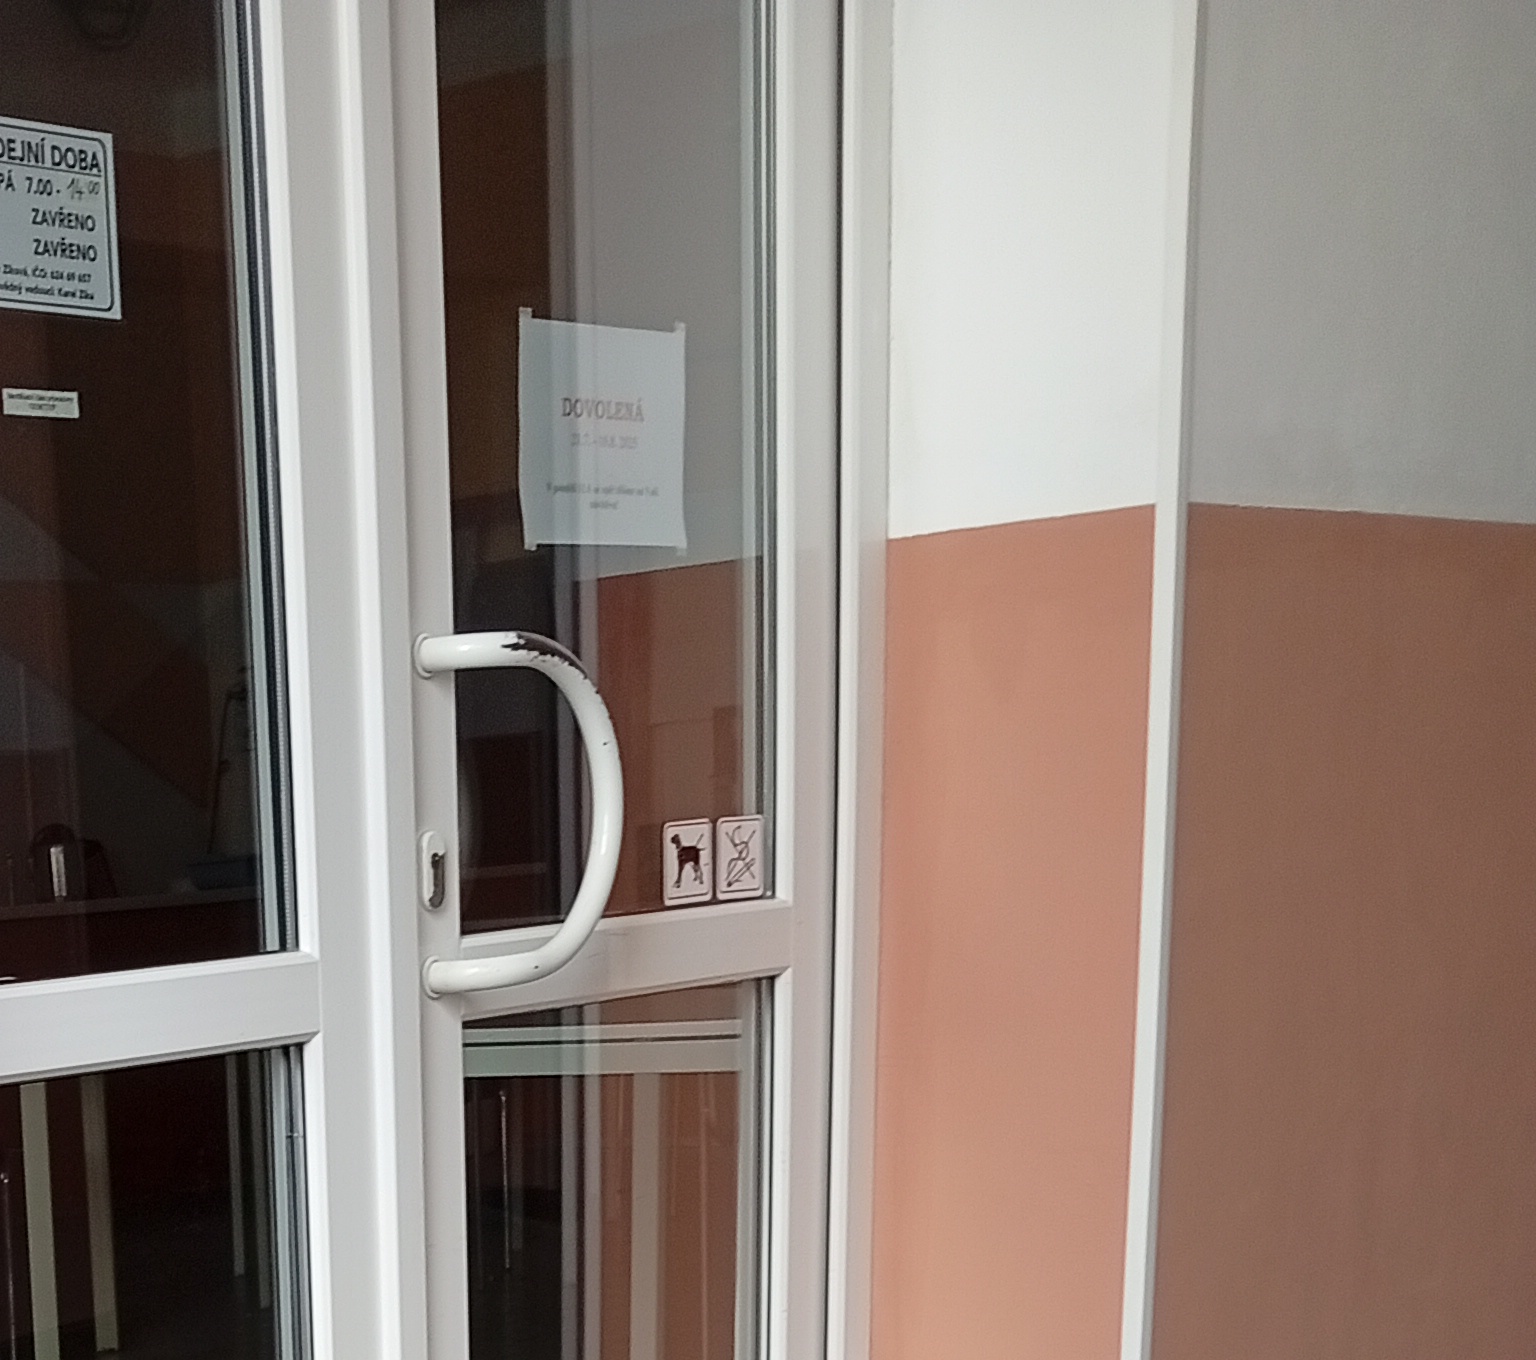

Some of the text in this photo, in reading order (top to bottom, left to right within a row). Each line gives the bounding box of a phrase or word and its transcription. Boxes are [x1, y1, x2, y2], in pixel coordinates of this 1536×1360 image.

[50, 145, 102, 173] DOBA
[25, 176, 53, 196] 7.00
[31, 206, 96, 232] ZAVŘENO
[33, 237, 97, 262] ZAVŘENO
[561, 397, 645, 422] DOVOLENÁ
